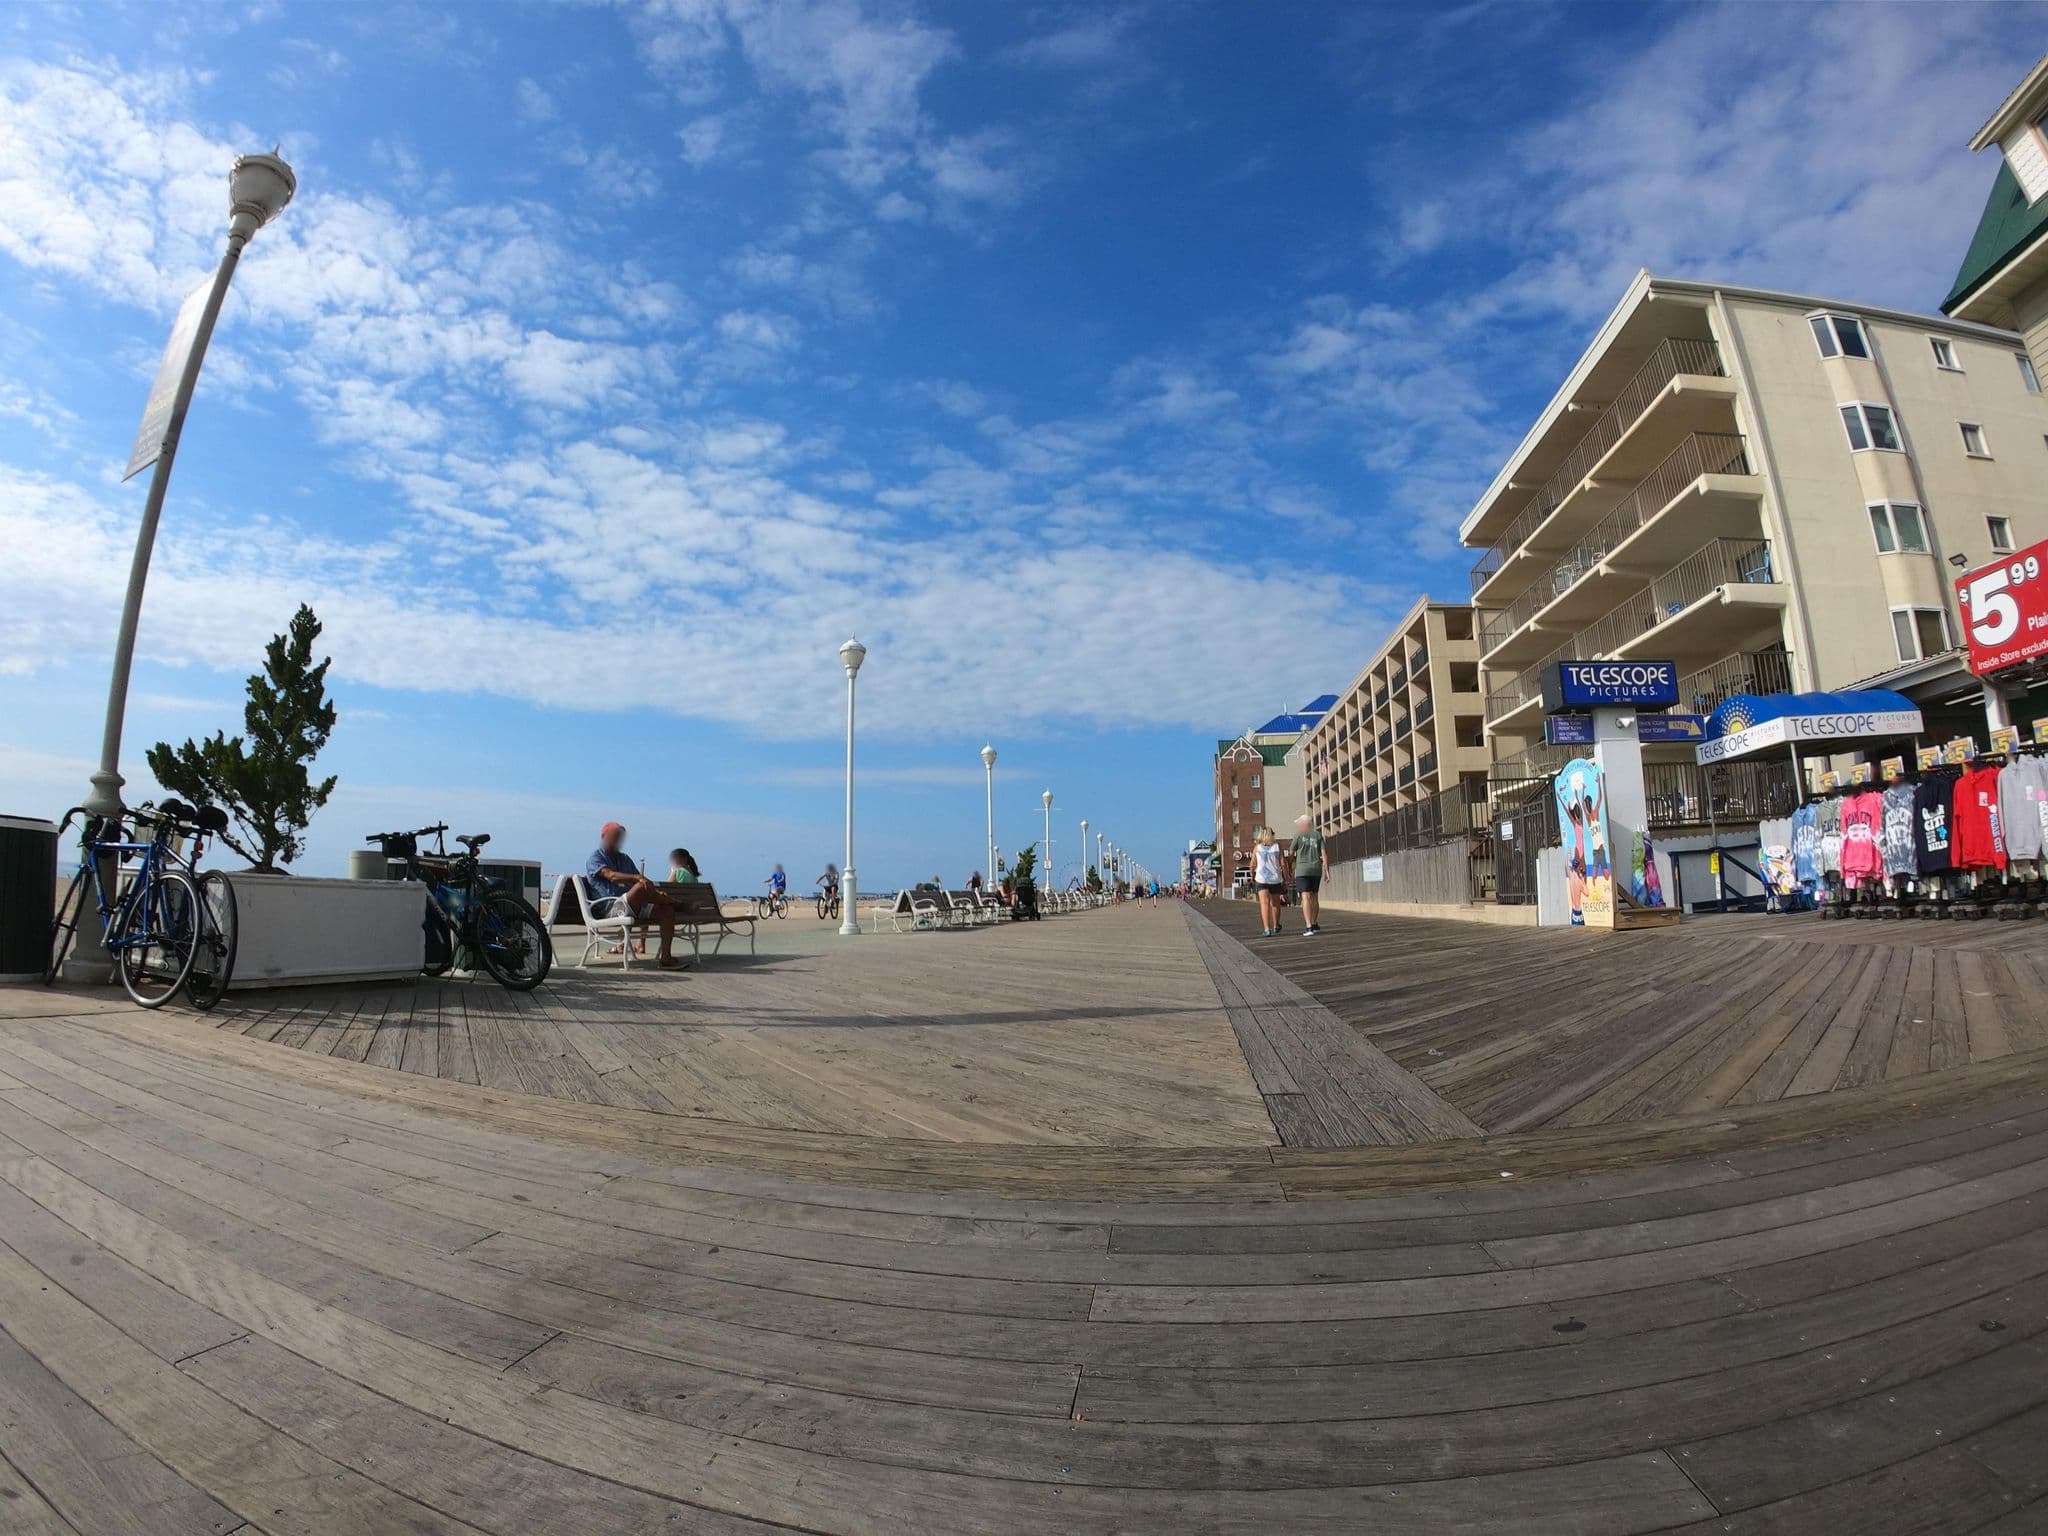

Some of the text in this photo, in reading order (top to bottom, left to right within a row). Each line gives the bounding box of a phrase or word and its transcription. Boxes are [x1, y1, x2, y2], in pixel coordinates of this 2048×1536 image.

[2027, 611, 2048, 631] Plai
[1977, 656, 1999, 670] Inside
[2000, 650, 2020, 663] Store
[1568, 667, 1669, 686] TELESCOPE
[1790, 715, 1876, 737] TELESCOPE
[1699, 733, 1749, 760] TELESCOPE
[1582, 901, 1610, 912] TELESCOPE
